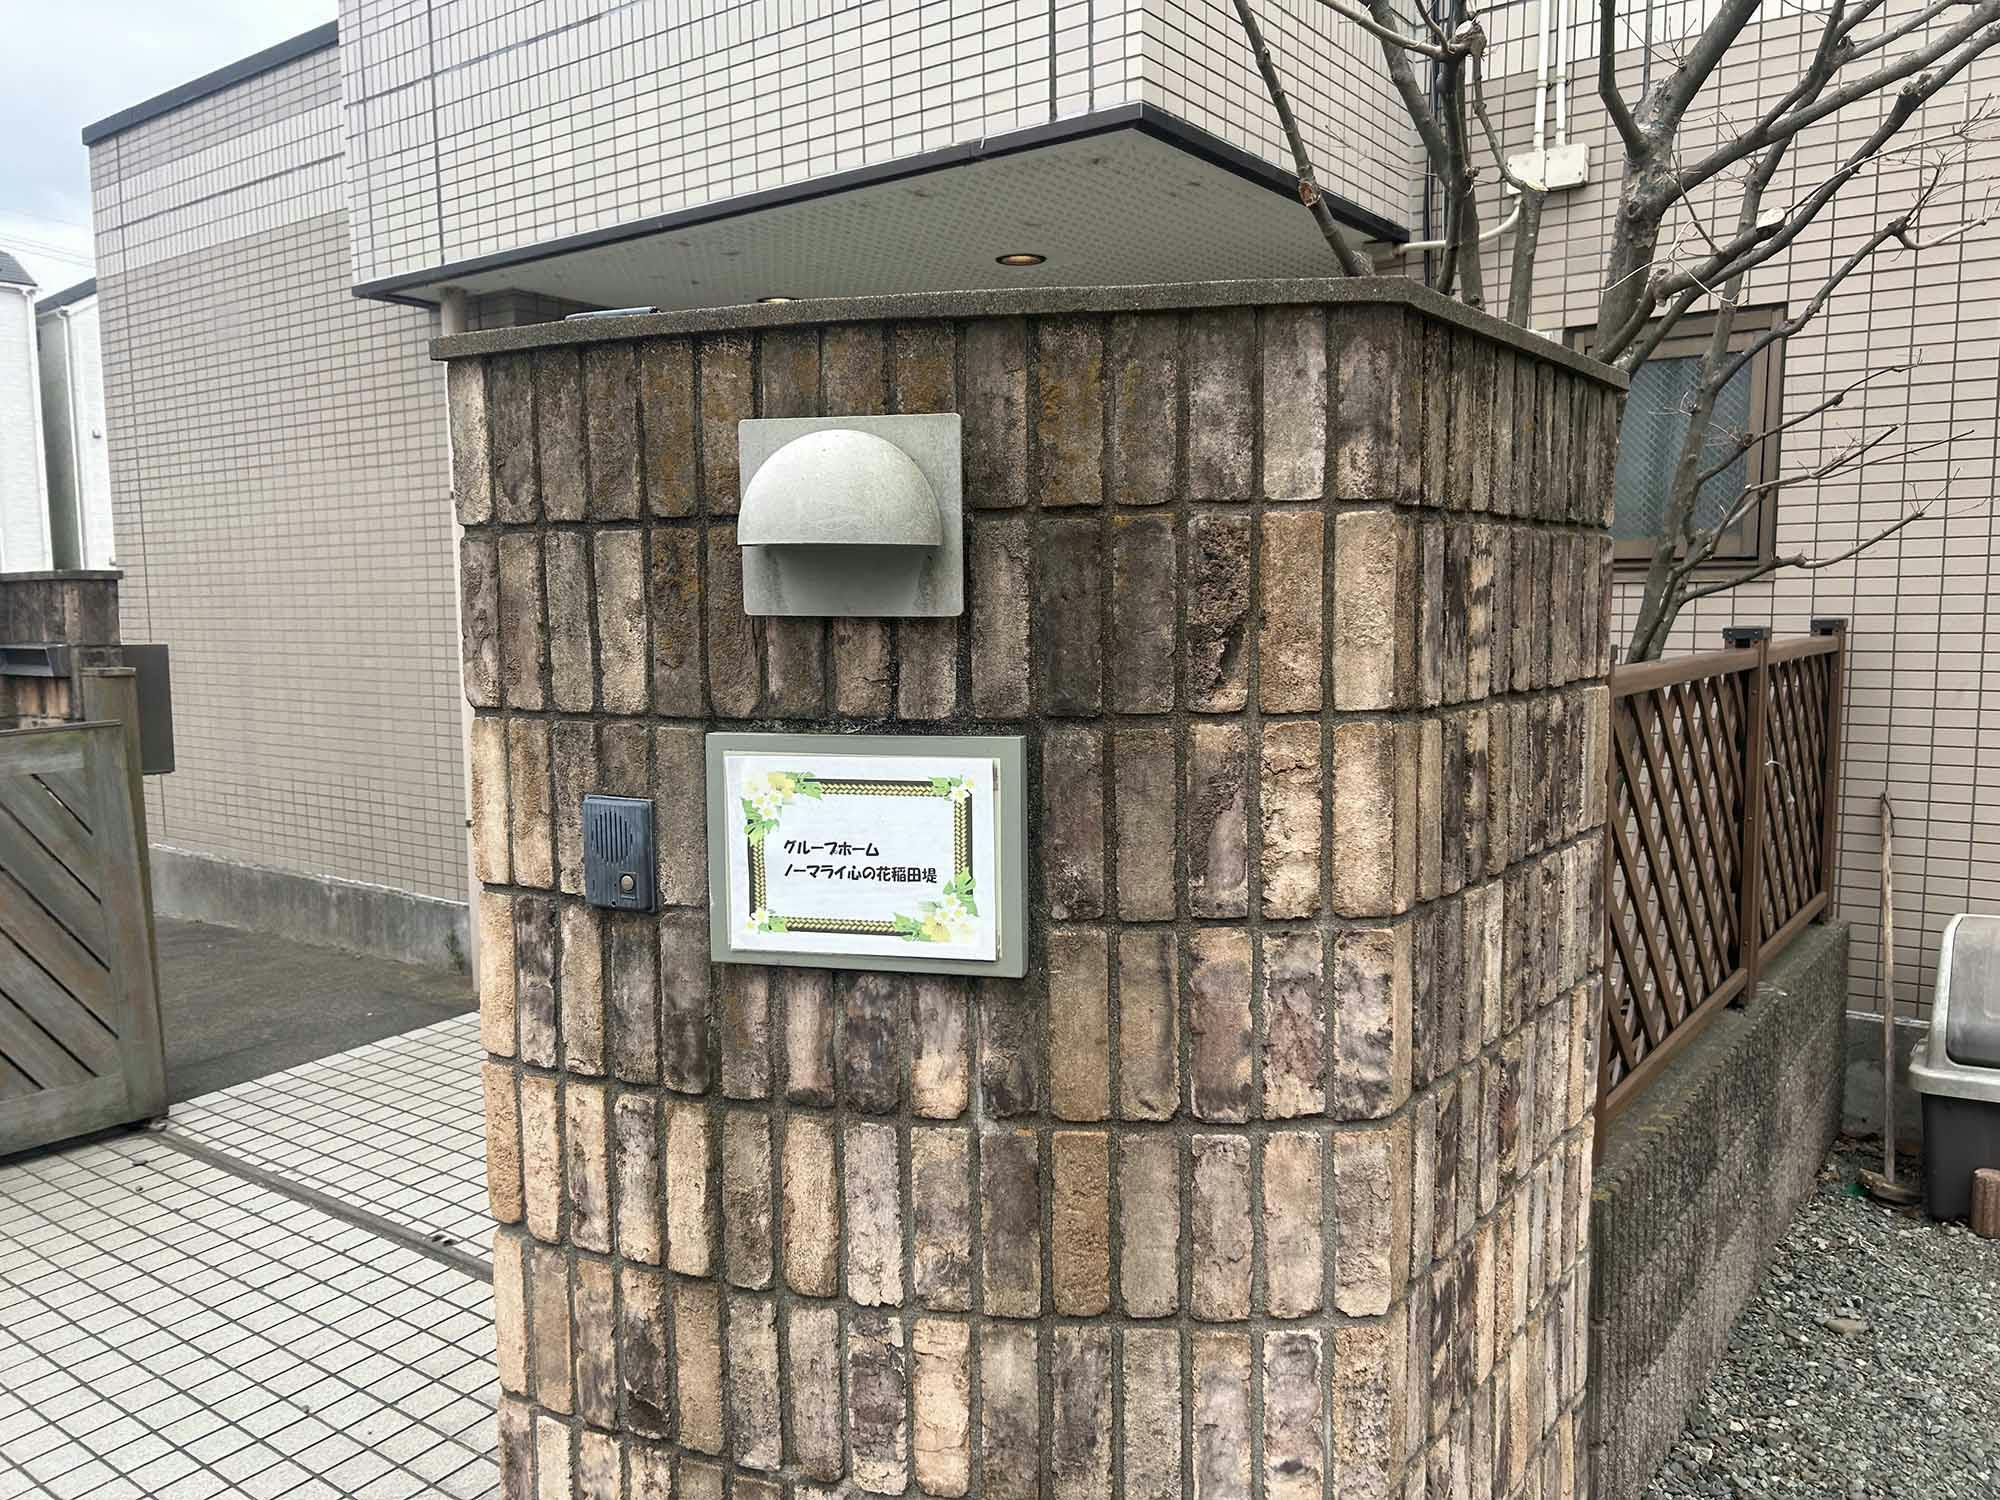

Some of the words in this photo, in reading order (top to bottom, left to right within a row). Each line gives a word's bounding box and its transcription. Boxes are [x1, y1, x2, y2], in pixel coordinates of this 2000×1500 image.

[783, 839, 880, 857] グループホーム
[784, 863, 938, 884] ノーマライ心の花稲田堤
